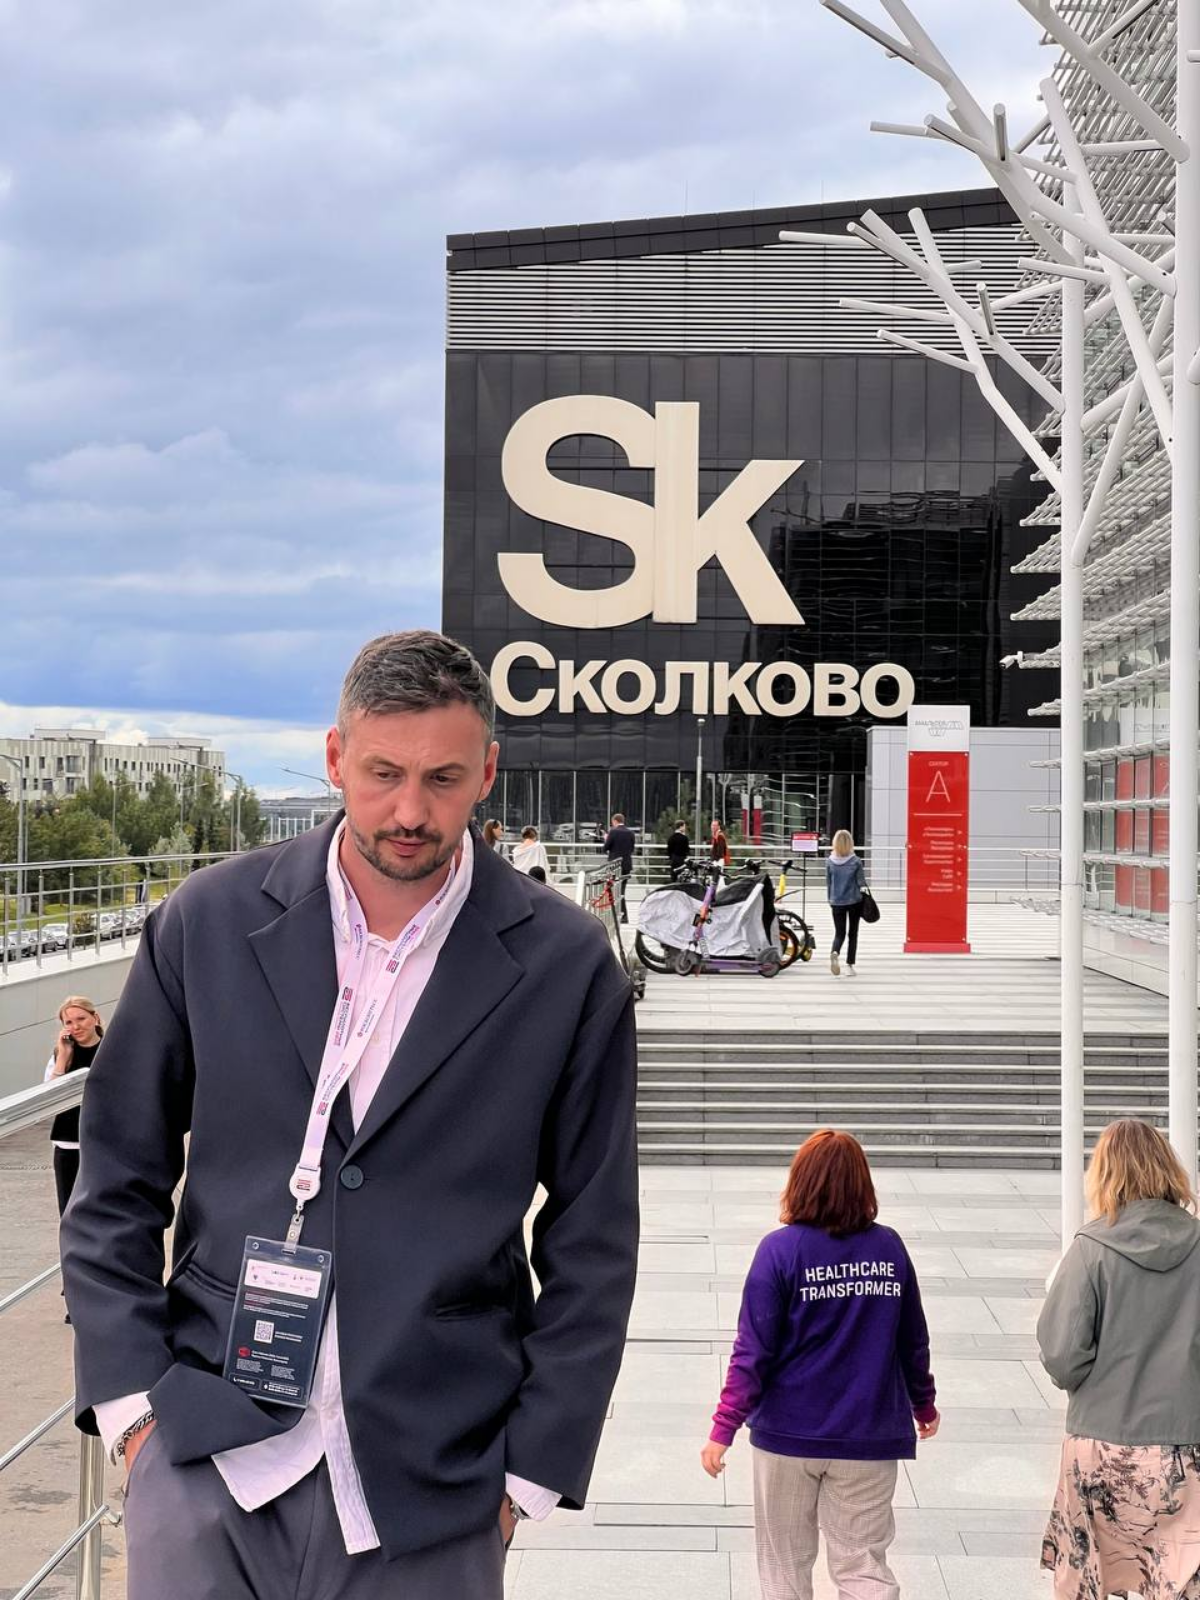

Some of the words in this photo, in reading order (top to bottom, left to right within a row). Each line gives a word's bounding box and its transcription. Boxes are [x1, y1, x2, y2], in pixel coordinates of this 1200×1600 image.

[497, 394, 806, 629] Sk
[805, 1261, 895, 1282] HEALTHCARE
[800, 1281, 901, 1302] TRANSFORMER
